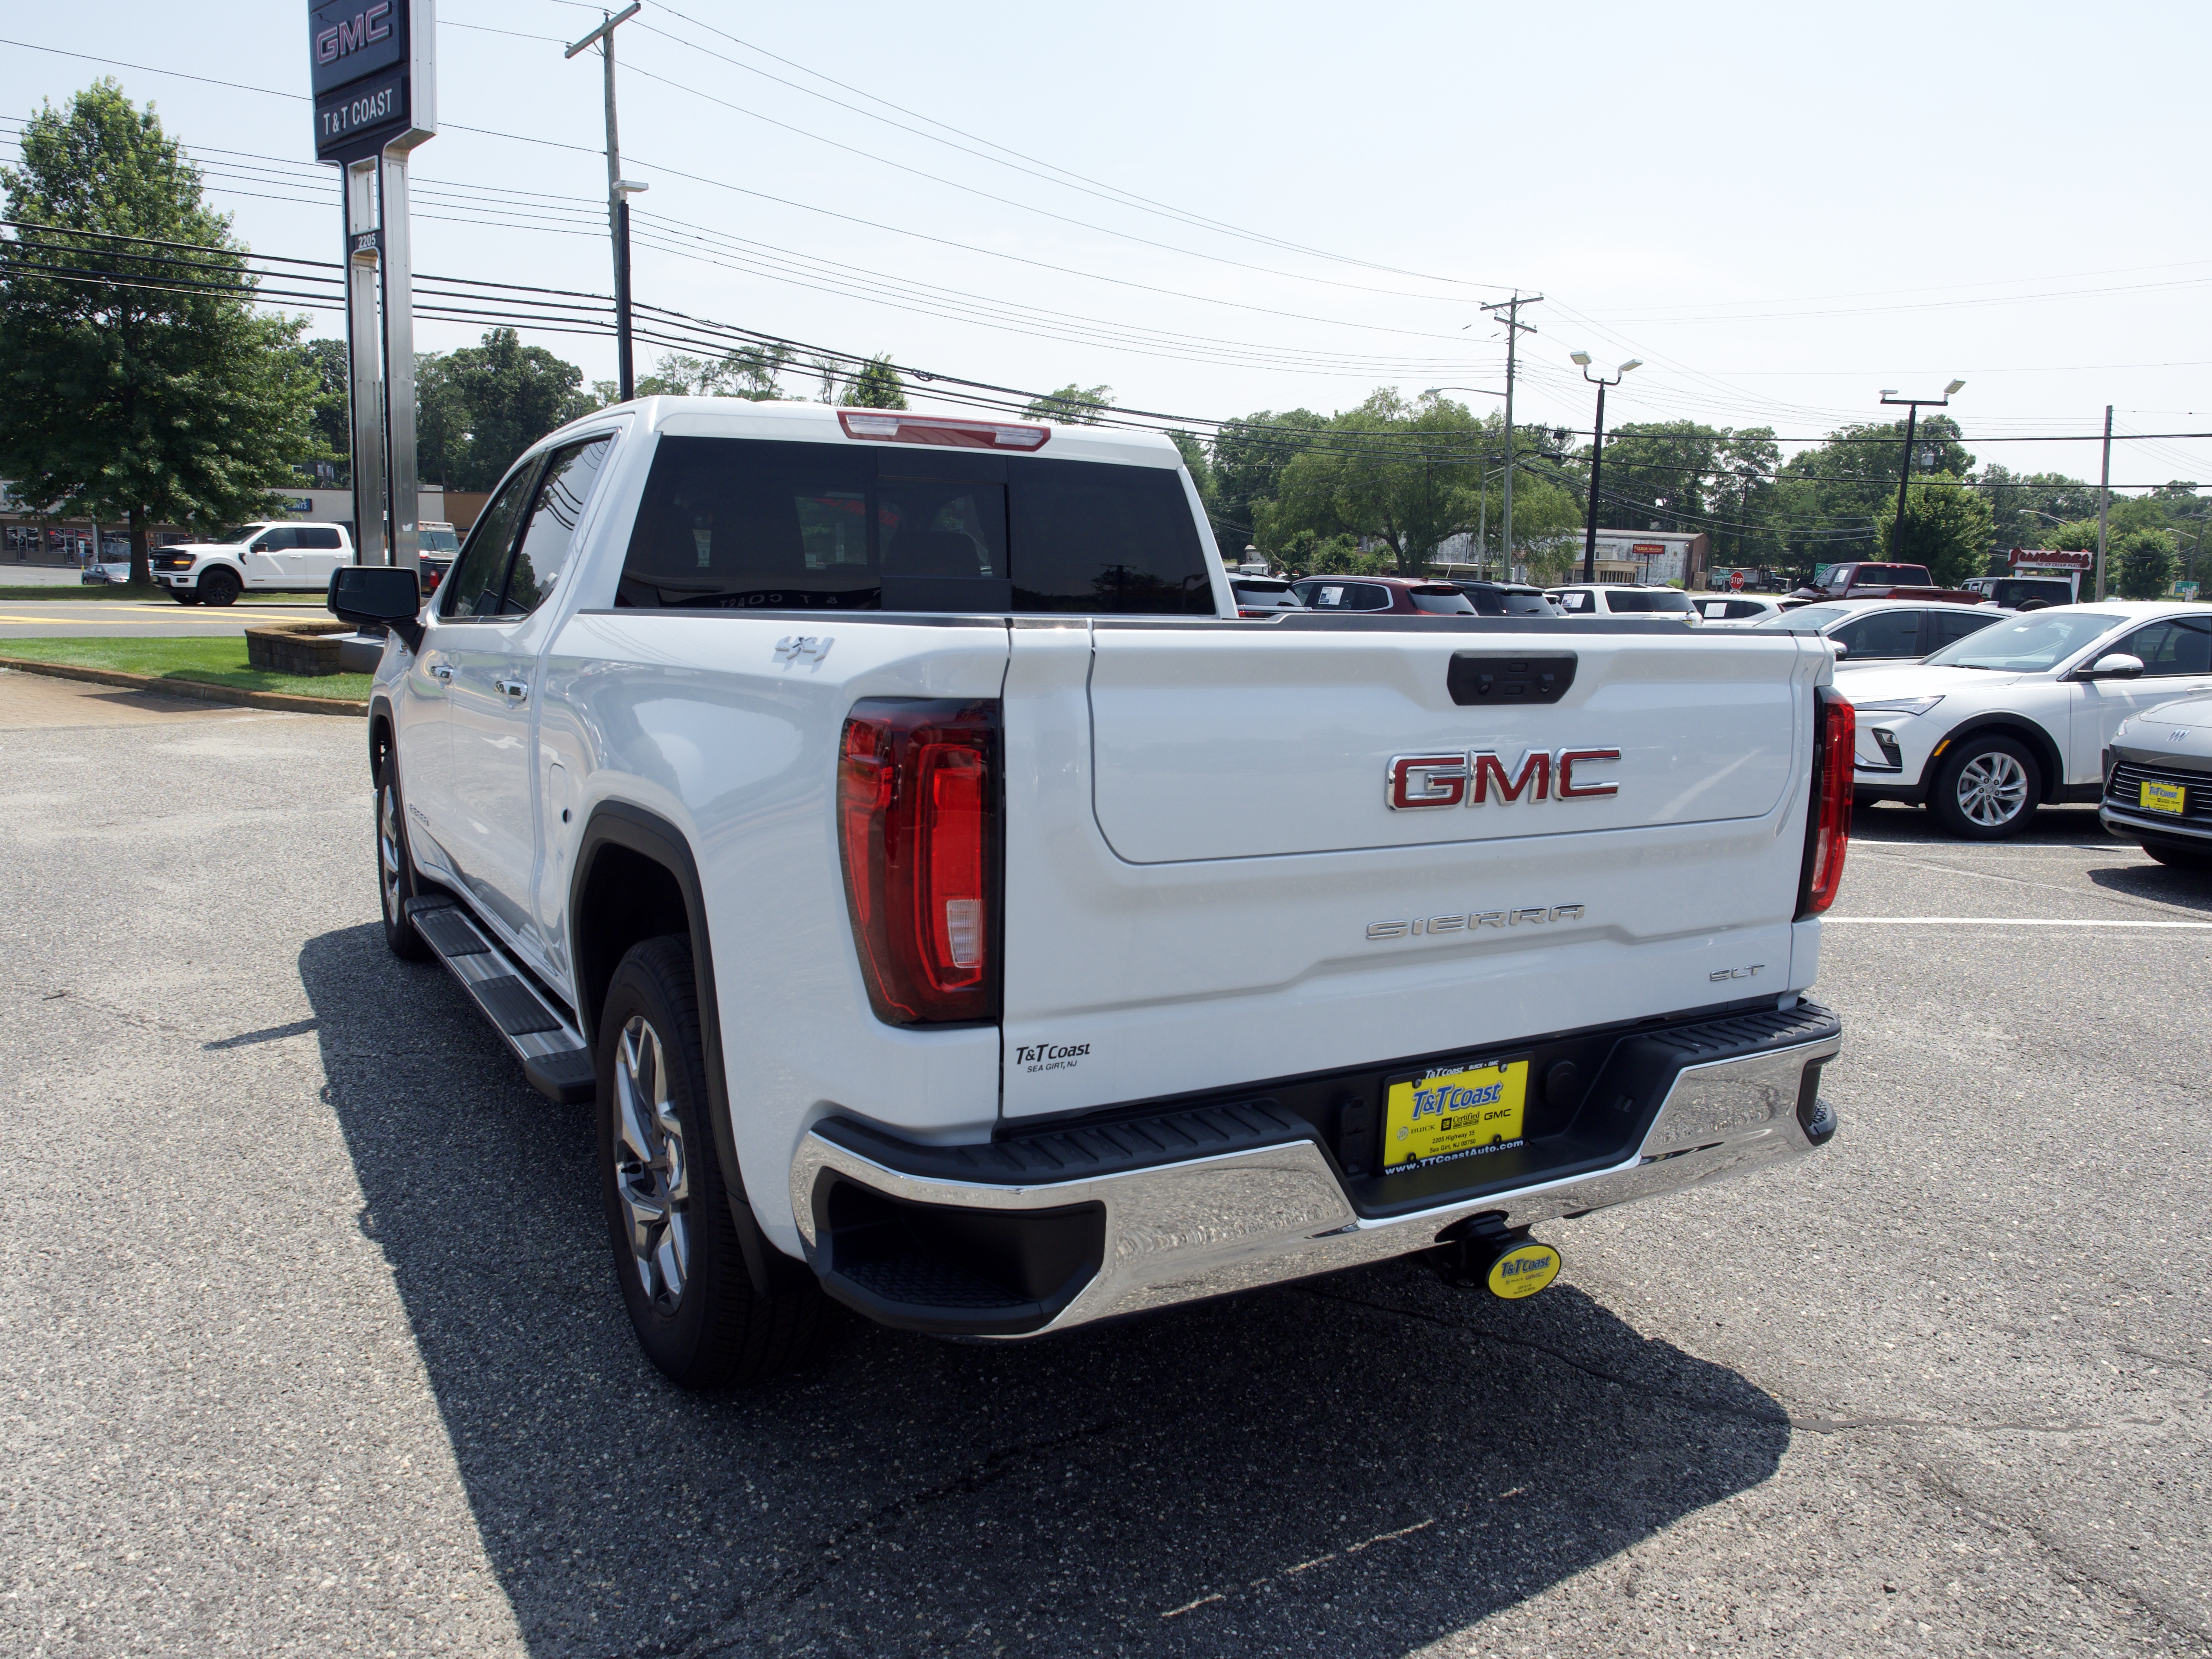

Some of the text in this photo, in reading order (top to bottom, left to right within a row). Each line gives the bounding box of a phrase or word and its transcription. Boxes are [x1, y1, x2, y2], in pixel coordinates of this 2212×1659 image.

[317, 2, 392, 66] GMC
[352, 89, 392, 125] COAST
[358, 233, 376, 249] 2205
[1385, 745, 1621, 811] GMC
[1367, 902, 1585, 939] SIERRA
[1710, 963, 1765, 981] SLT
[1016, 1043, 1090, 1065] T&T Coast
[1027, 1065, 1043, 1073] SEA
[1046, 1062, 1065, 1070] GIRT,
[1426, 1068, 1443, 1079] T&T
[1442, 1066, 1464, 1076] Coast
[1412, 1080, 1504, 1121] T&T Coast
[1410, 1124, 1435, 1134] BUICK
[1453, 1111, 1480, 1123] Certified
[1484, 1109, 1512, 1121] GMC
[1432, 1136, 1444, 1144] 2205
[1445, 1132, 1468, 1141] Highway
[1461, 1138, 1476, 1147] 08750
[1385, 1140, 1524, 1175] www.TTCoastAuto.com
[1502, 1255, 1551, 1278] T&T Coast
